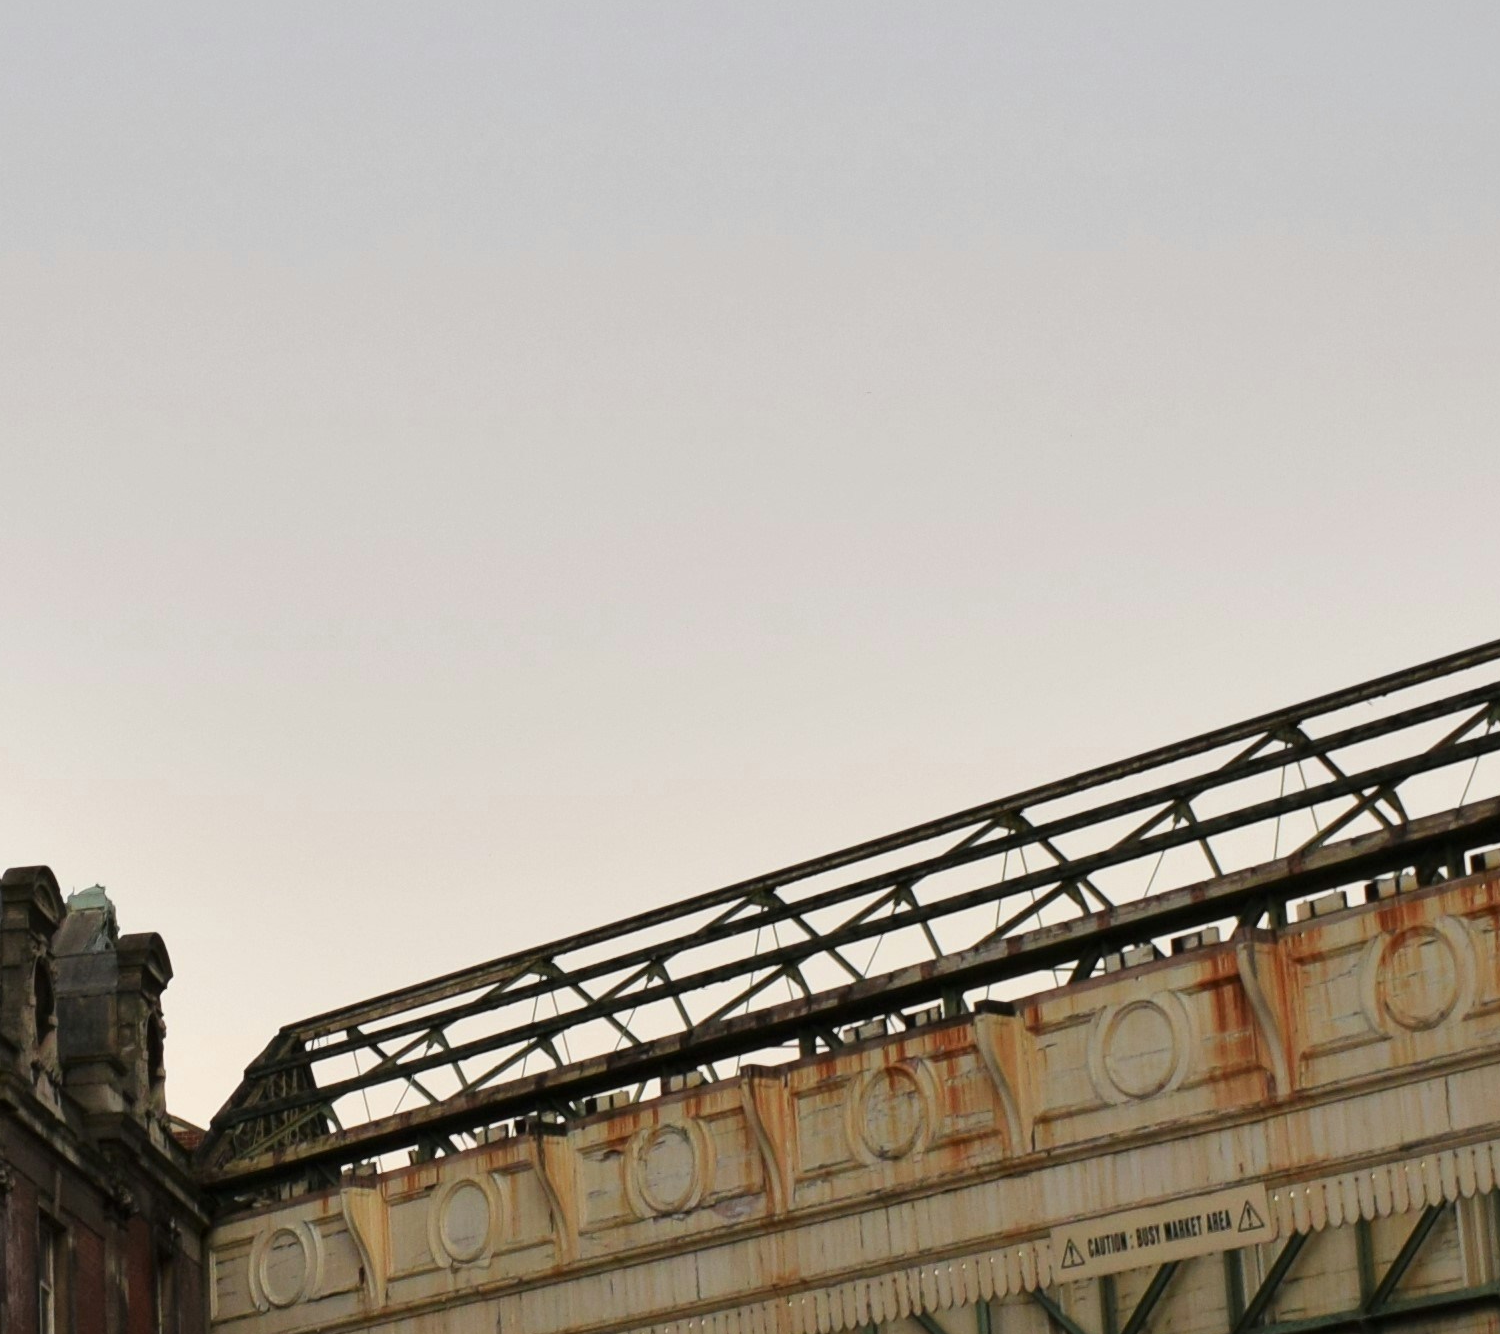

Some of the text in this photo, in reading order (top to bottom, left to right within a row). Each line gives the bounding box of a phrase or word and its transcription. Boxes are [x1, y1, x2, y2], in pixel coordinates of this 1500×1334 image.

[1087, 1231, 1128, 1259] CAUTION
[1136, 1222, 1161, 1248] BUSY
[1163, 1214, 1202, 1242] MARKET
[1206, 1209, 1232, 1234] AREA
